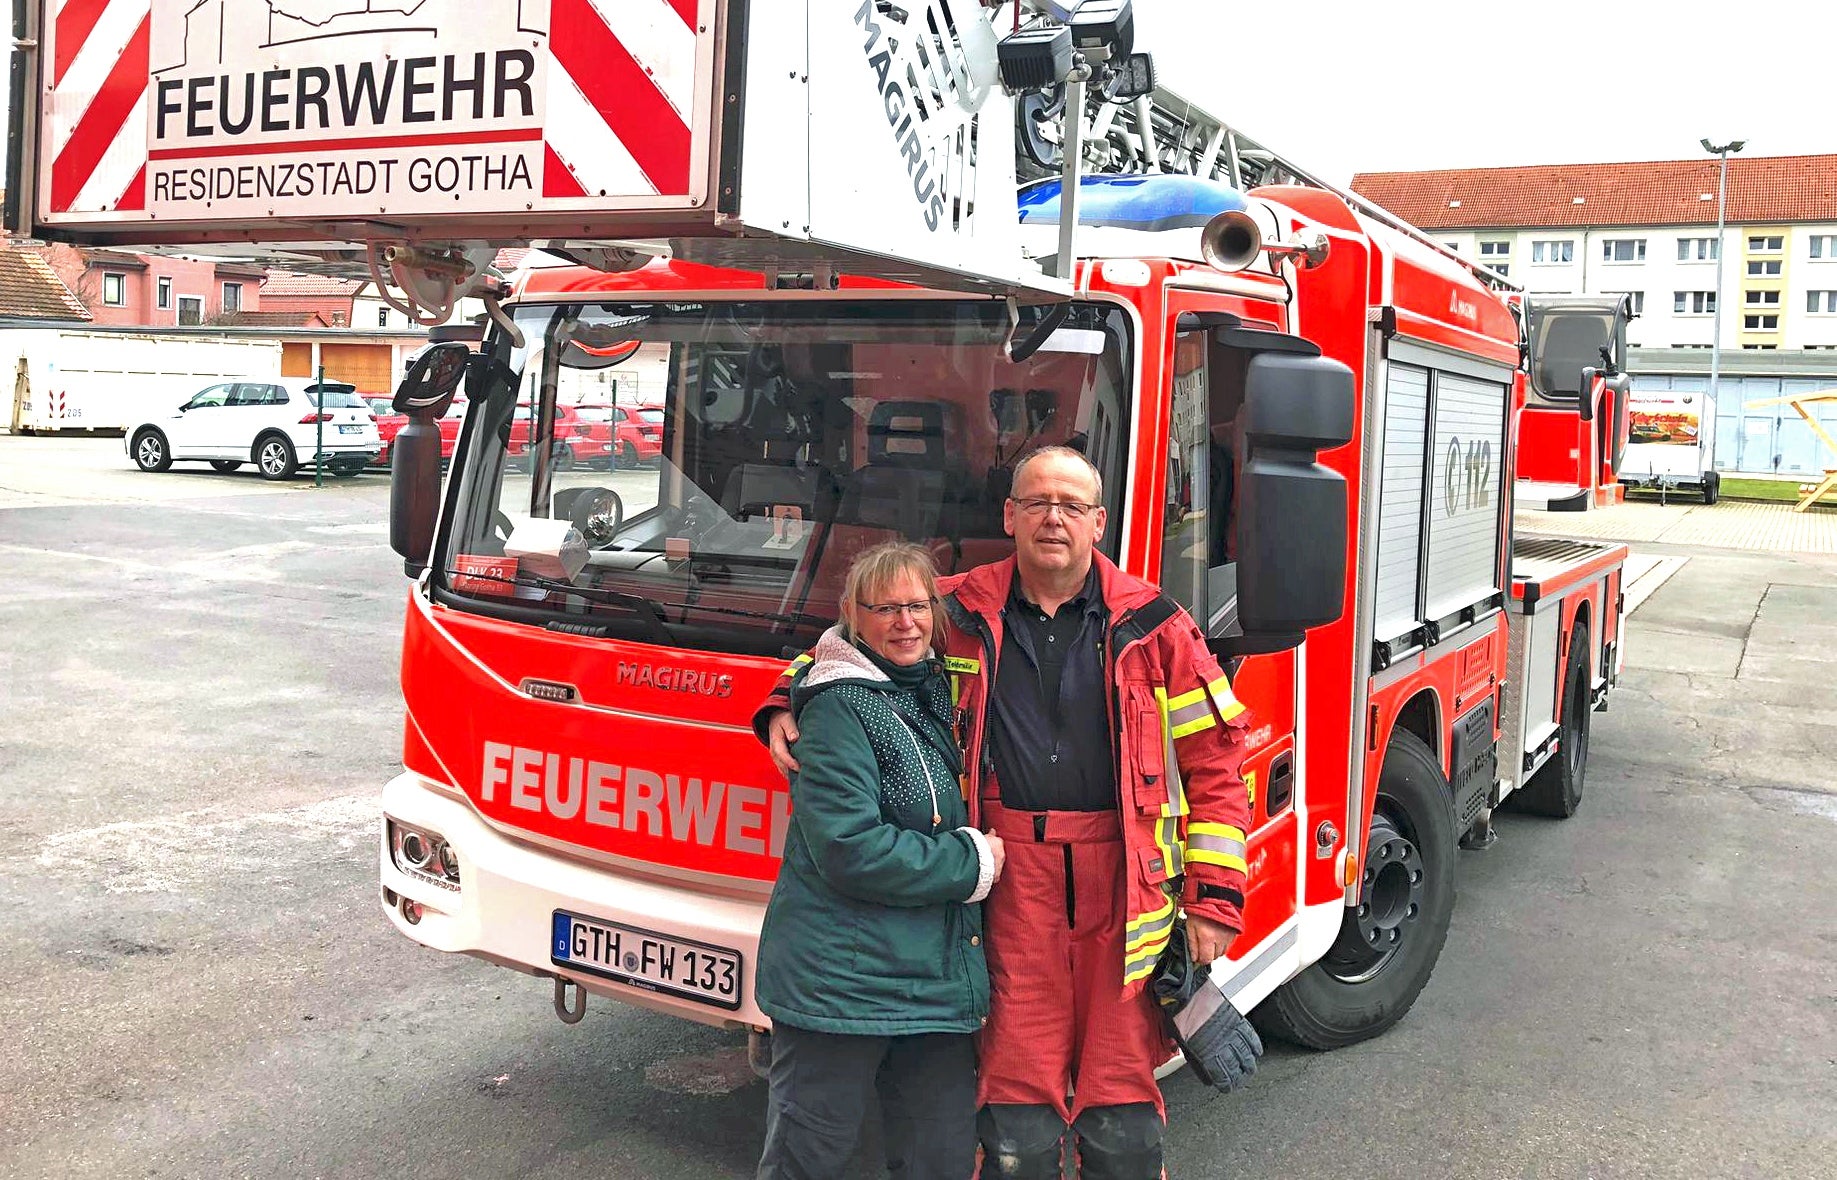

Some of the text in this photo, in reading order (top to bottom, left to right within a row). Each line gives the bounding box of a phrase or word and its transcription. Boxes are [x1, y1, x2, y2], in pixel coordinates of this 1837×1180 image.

[156, 48, 535, 139] FEUERWEHR
[854, 0, 944, 232] MAGIRUS
[154, 160, 398, 201] RESIDENZSTADT
[408, 154, 533, 194] GOTHA
[1465, 439, 1491, 511] 112
[465, 565, 488, 581] DLK
[616, 660, 735, 699] MAGIRUS
[558, 922, 736, 995] D GTH FW 133
